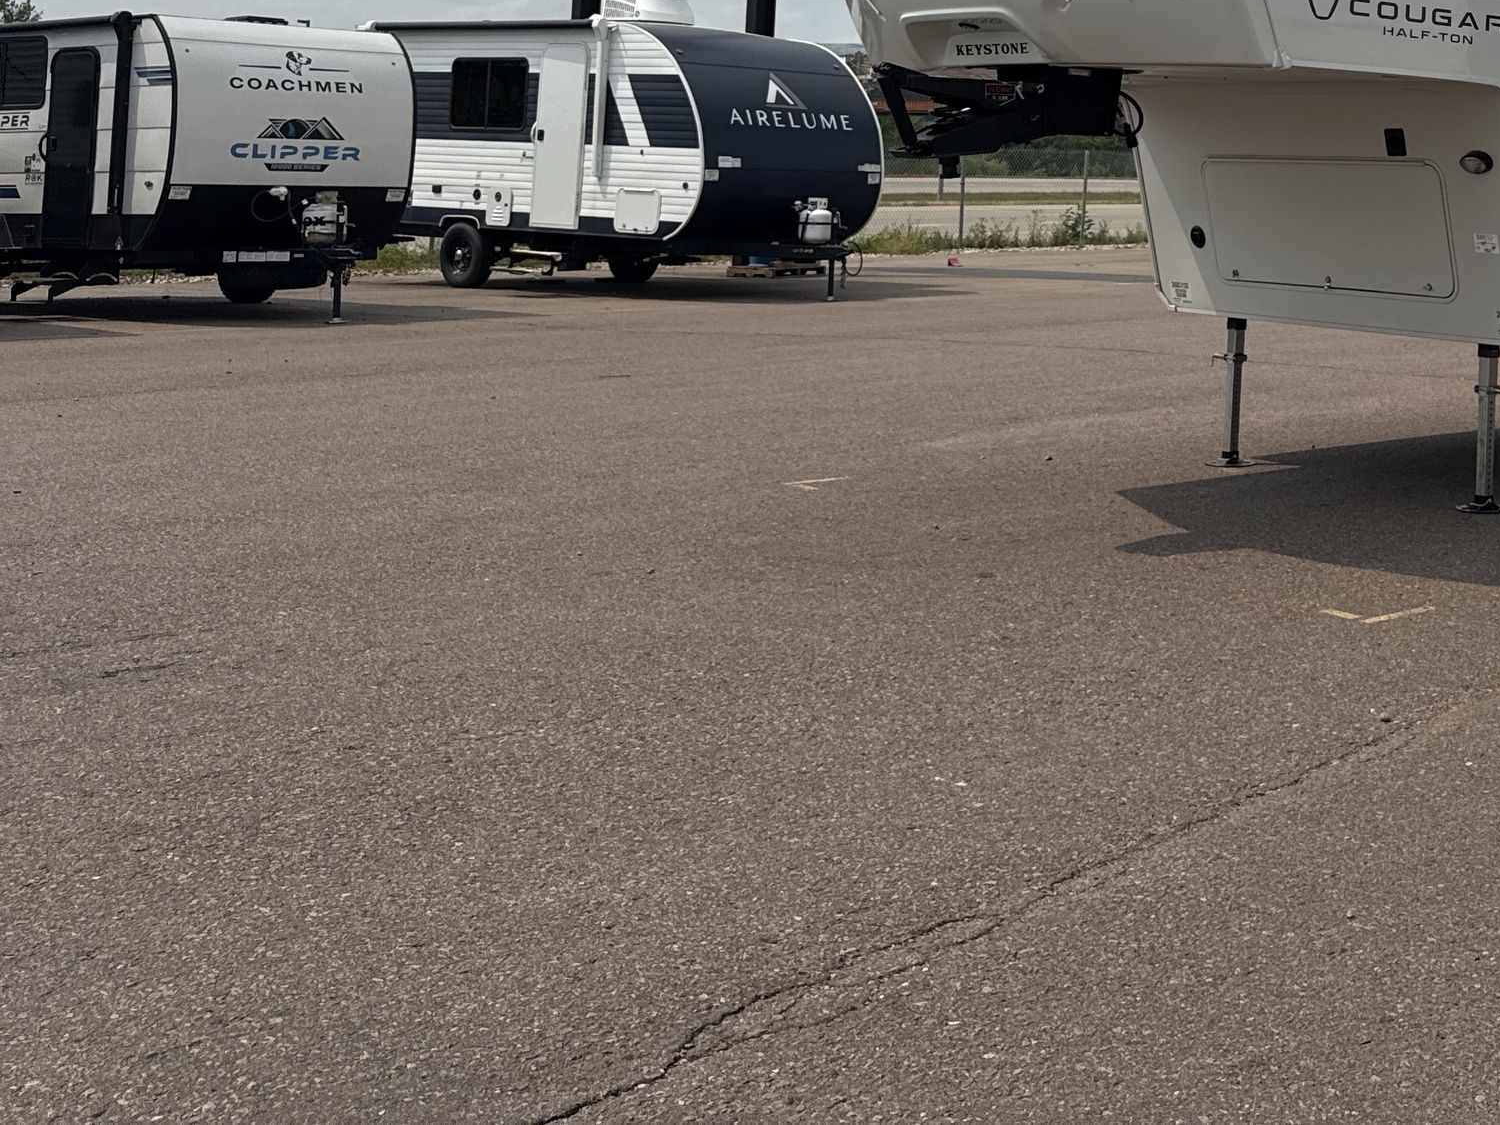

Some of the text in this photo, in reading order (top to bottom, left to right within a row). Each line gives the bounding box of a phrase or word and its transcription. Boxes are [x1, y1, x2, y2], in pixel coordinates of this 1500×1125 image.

[1382, 25, 1474, 46] HALF-TON
[955, 42, 1030, 56] KEYSTONE
[229, 76, 364, 94] COACHMEN
[730, 98, 853, 130] AIRELUME
[230, 142, 360, 161] CLIPPER
